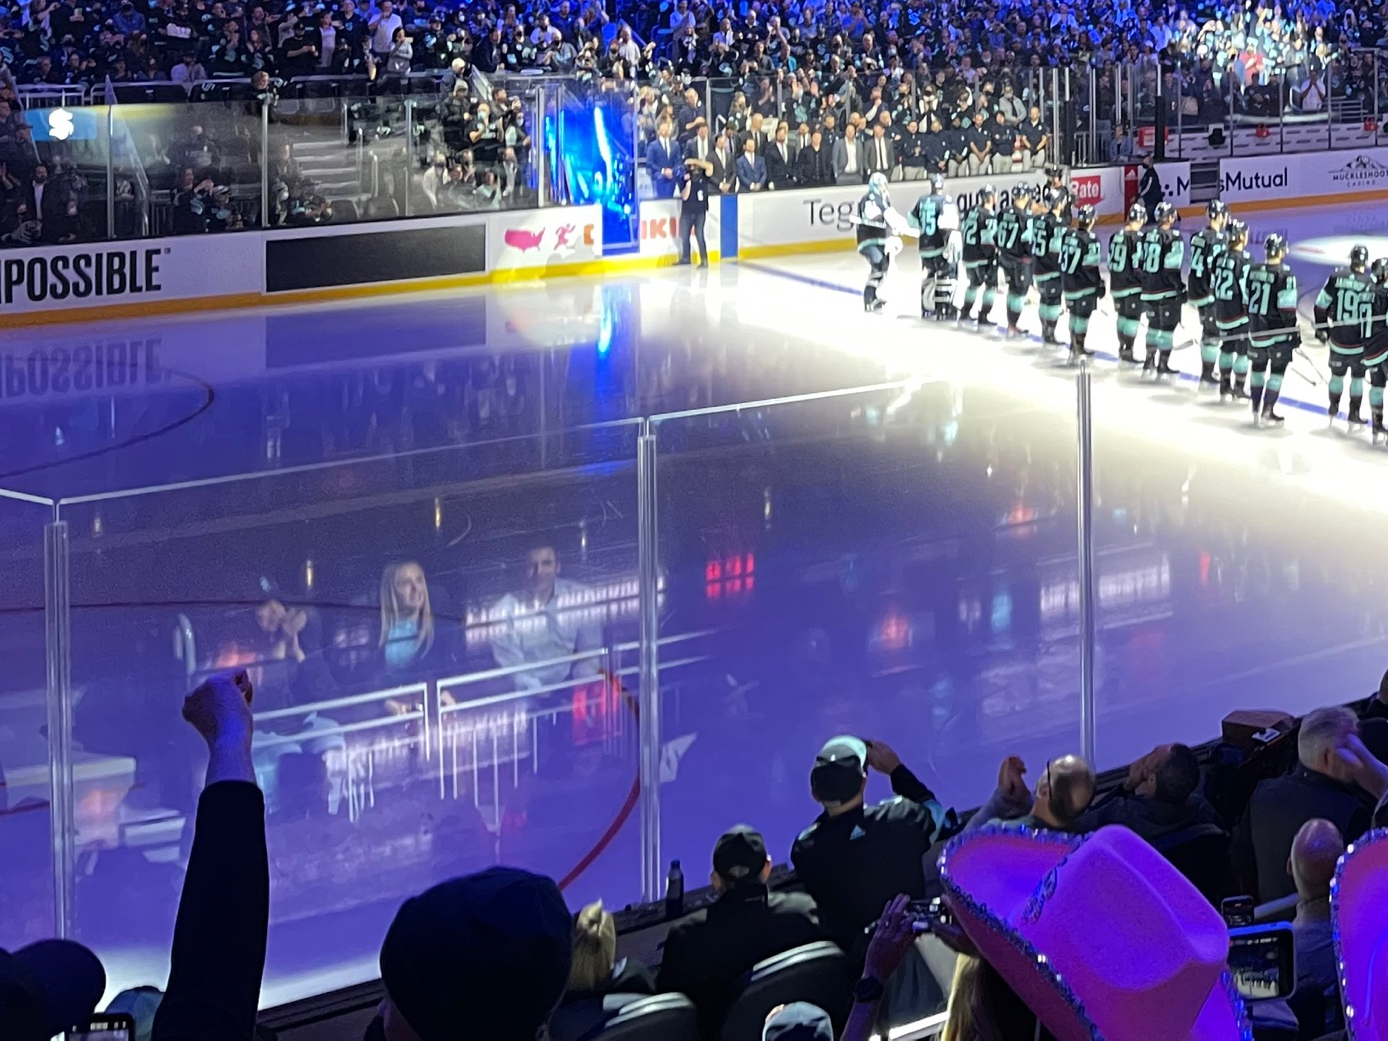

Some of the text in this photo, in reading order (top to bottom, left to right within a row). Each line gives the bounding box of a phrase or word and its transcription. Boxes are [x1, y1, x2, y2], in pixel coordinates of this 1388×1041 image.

[803, 198, 855, 232] Teg
[0, 249, 161, 304] POSSIBLE
[1249, 281, 1270, 315] 21
